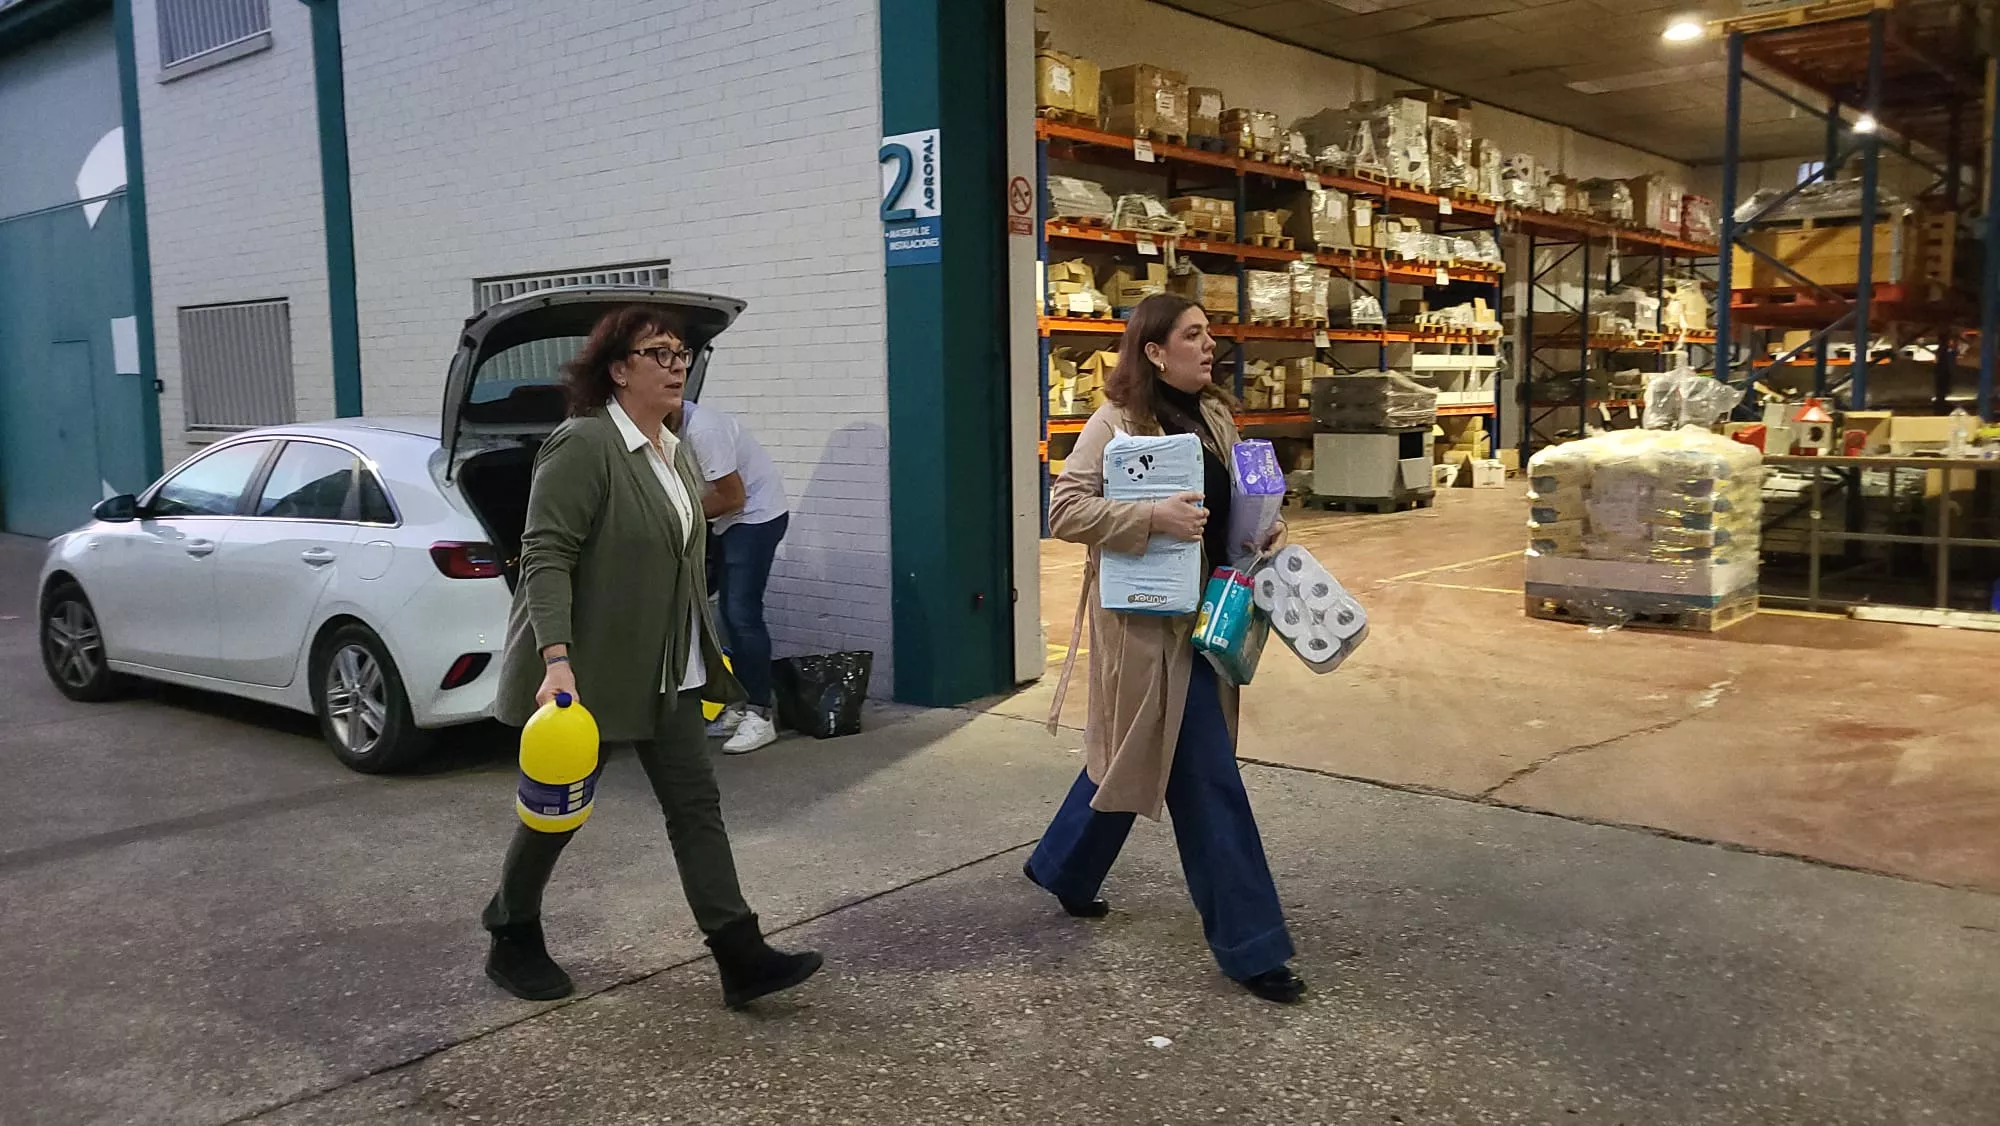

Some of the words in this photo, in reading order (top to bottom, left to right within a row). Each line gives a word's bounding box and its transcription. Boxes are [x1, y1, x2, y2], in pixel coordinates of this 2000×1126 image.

[879, 143, 916, 220] 2
[923, 135, 935, 209] AGROPAL
[1133, 593, 1167, 604] nunex
